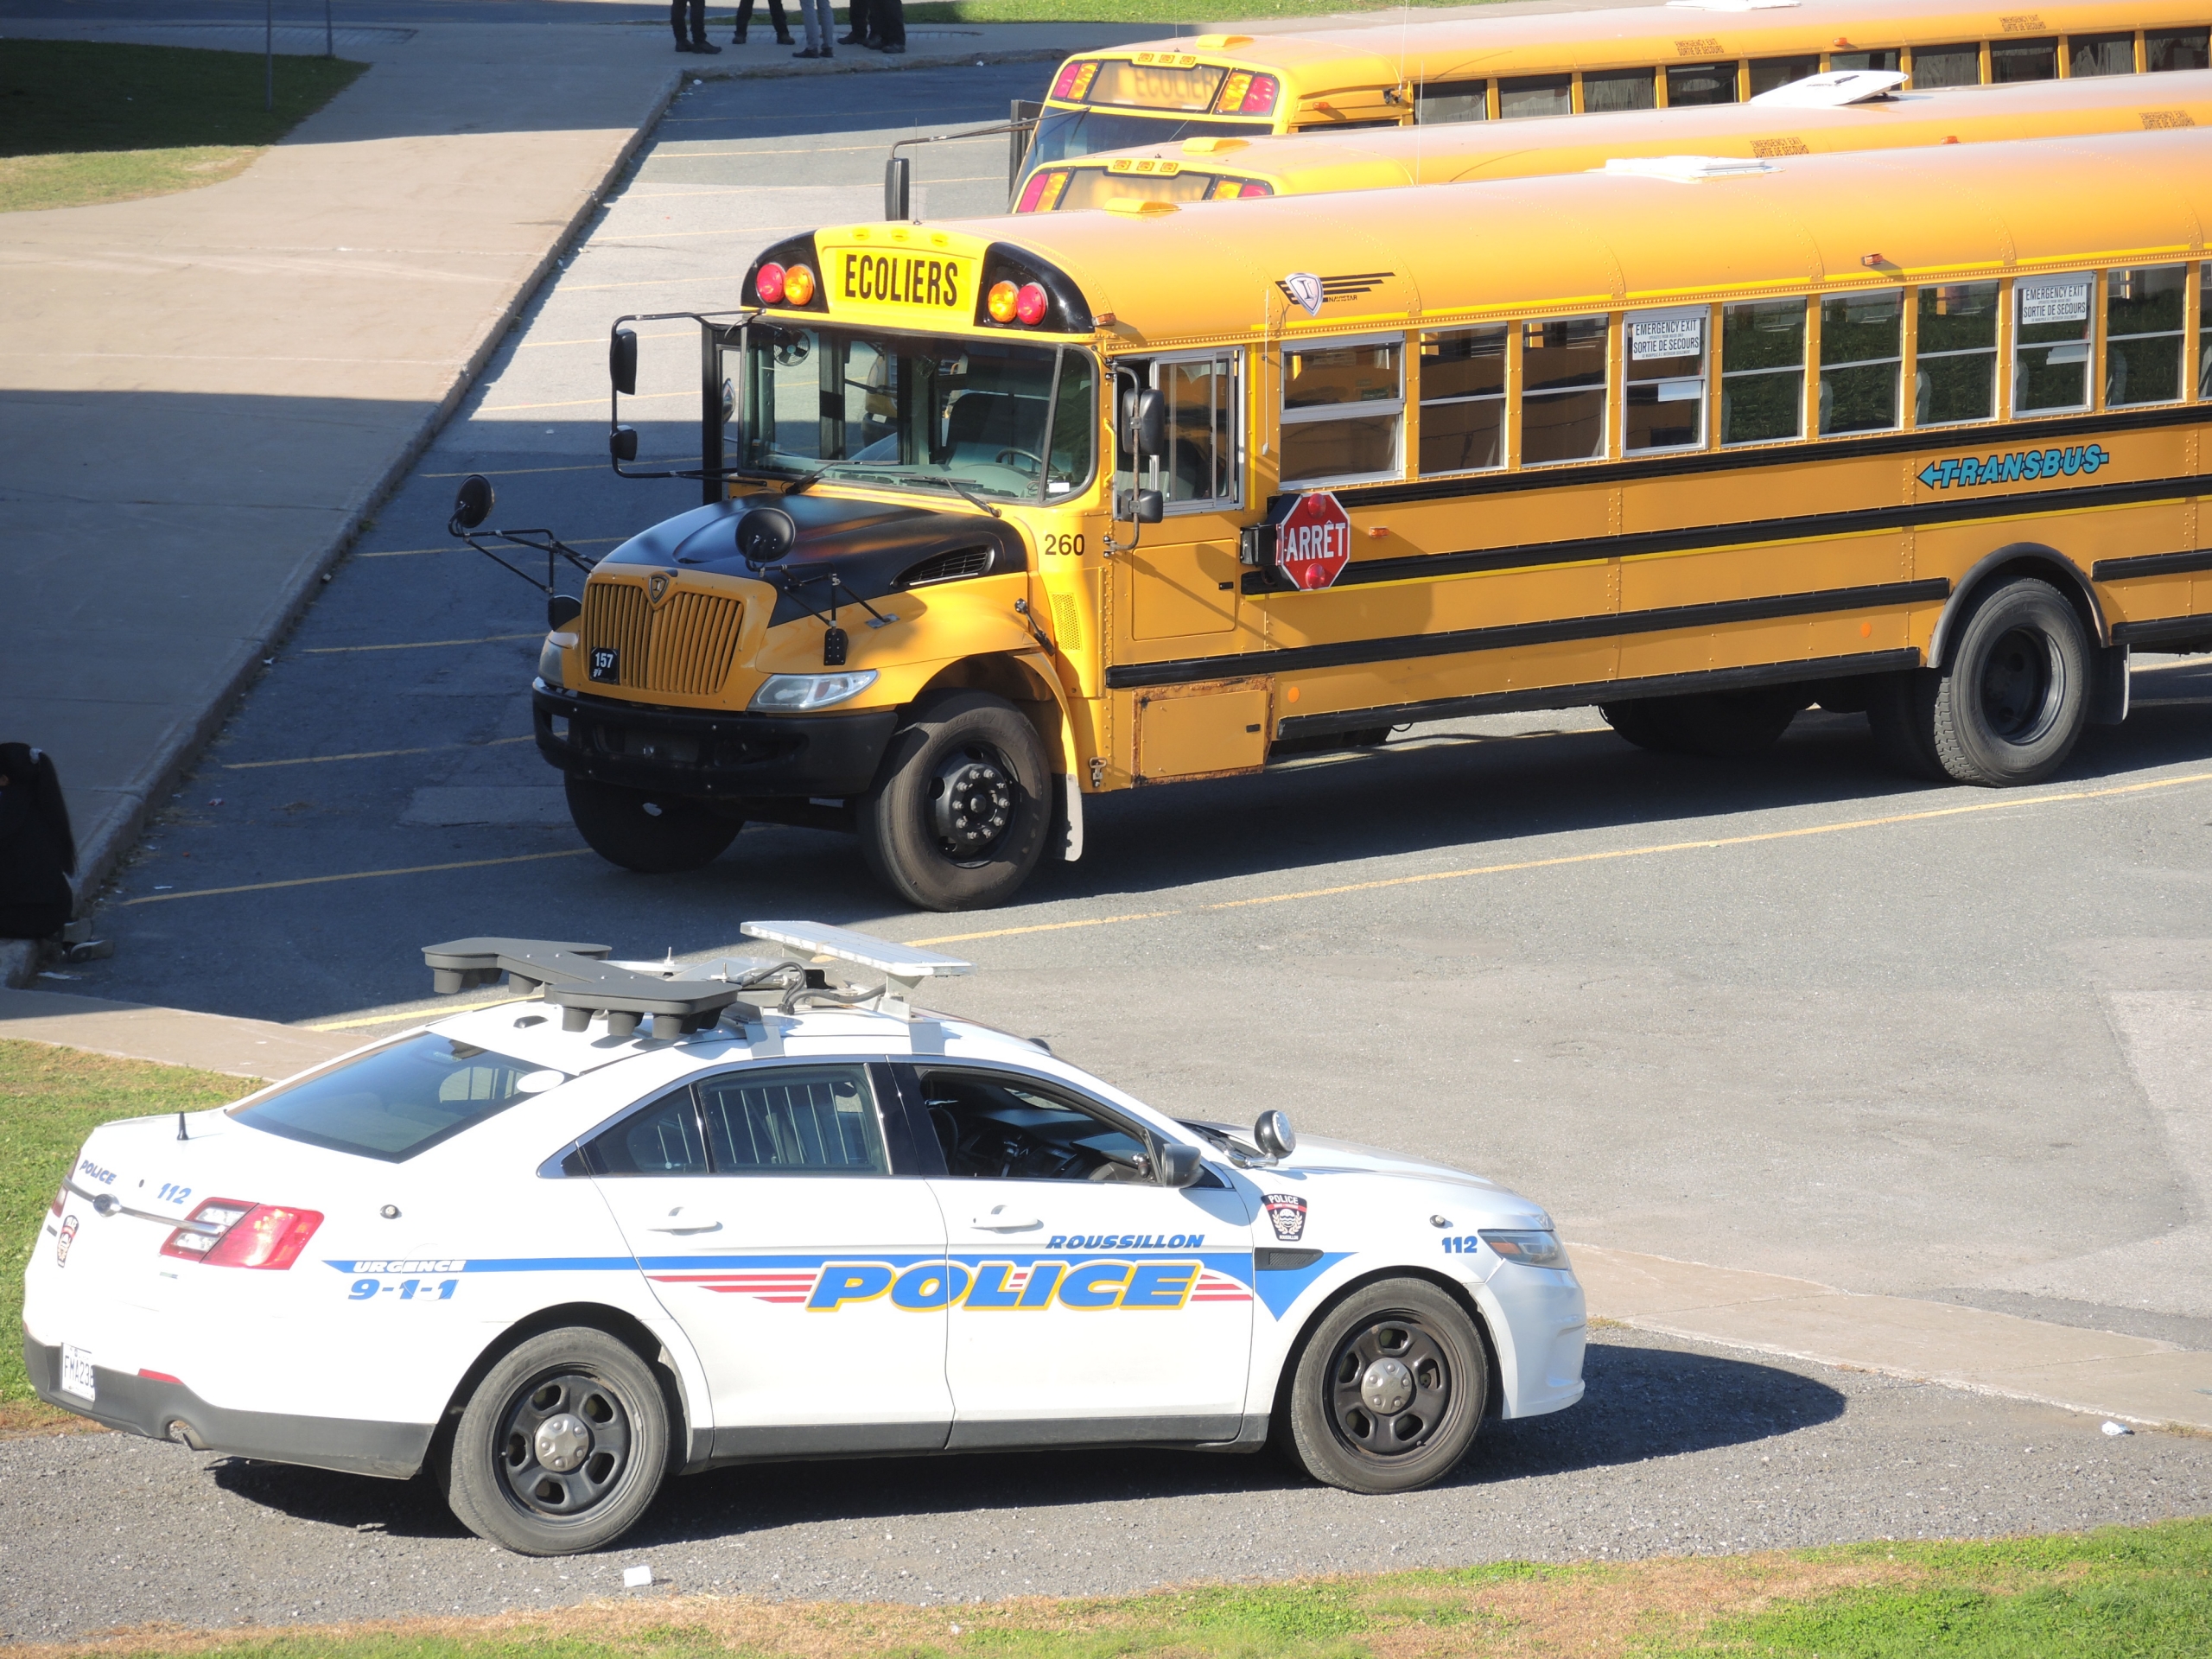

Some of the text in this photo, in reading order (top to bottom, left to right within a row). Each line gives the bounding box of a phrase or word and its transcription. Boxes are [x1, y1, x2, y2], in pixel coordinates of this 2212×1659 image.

[1774, 146, 1783, 156] DE
[845, 254, 958, 307] ECOLIERS
[2025, 284, 2084, 301] EMERGENCY EXIT
[2024, 306, 2046, 318] SORTIE
[2047, 304, 2056, 315] DE
[2056, 302, 2086, 315] SECOURS
[1636, 319, 1697, 335] EMERGENCY EXIT
[1633, 336, 1700, 353] SORTIE DE SECOURS
[1940, 443, 2102, 489] TRANSBUS
[1045, 533, 1085, 556] 260
[1286, 520, 1346, 562] ARRÊT
[595, 652, 613, 668] 157
[79, 1160, 118, 1185] POLICE
[157, 1183, 192, 1205] 112
[1268, 1194, 1299, 1205] POLICE
[1046, 1234, 1205, 1249] ROUSSILLON
[1441, 1236, 1478, 1254] 112
[353, 1260, 467, 1273] URGENCE
[347, 1279, 459, 1300] 9-1-1
[805, 1262, 1202, 1312] POLICE
